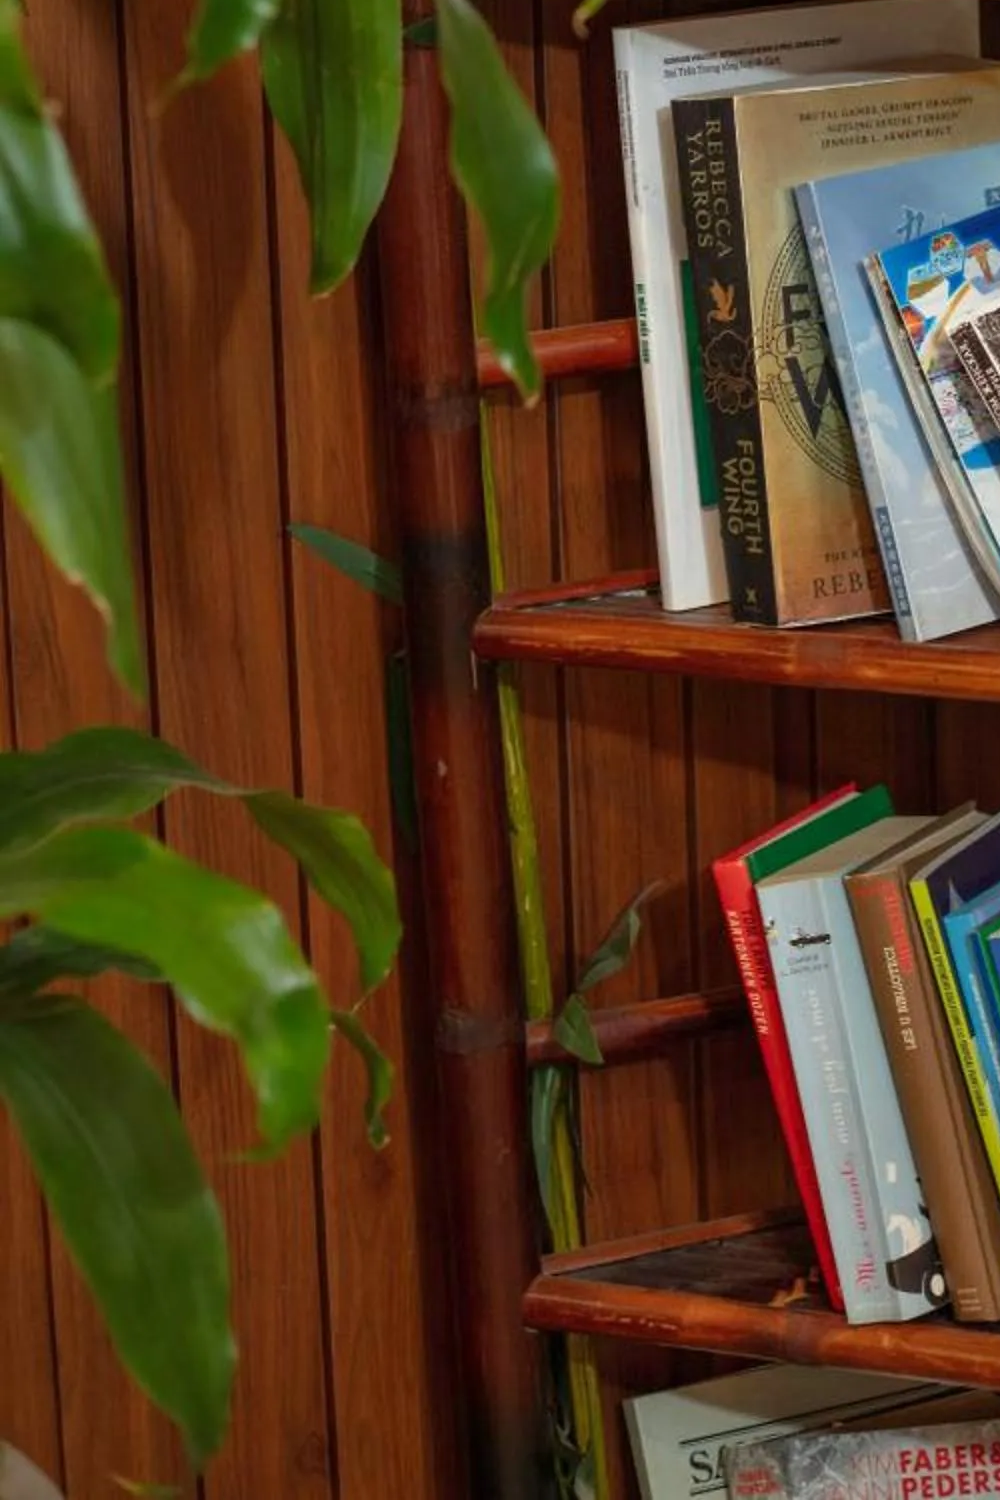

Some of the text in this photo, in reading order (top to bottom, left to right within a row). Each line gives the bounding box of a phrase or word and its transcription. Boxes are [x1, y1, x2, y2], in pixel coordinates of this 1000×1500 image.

[684, 132, 715, 249] YARROS
[704, 118, 734, 259] REBECCA
[721, 457, 744, 536] WING
[735, 439, 765, 554] FOURTH
[811, 568, 881, 599] REBE
[727, 910, 769, 1036] KARTONNEN DOZEN
